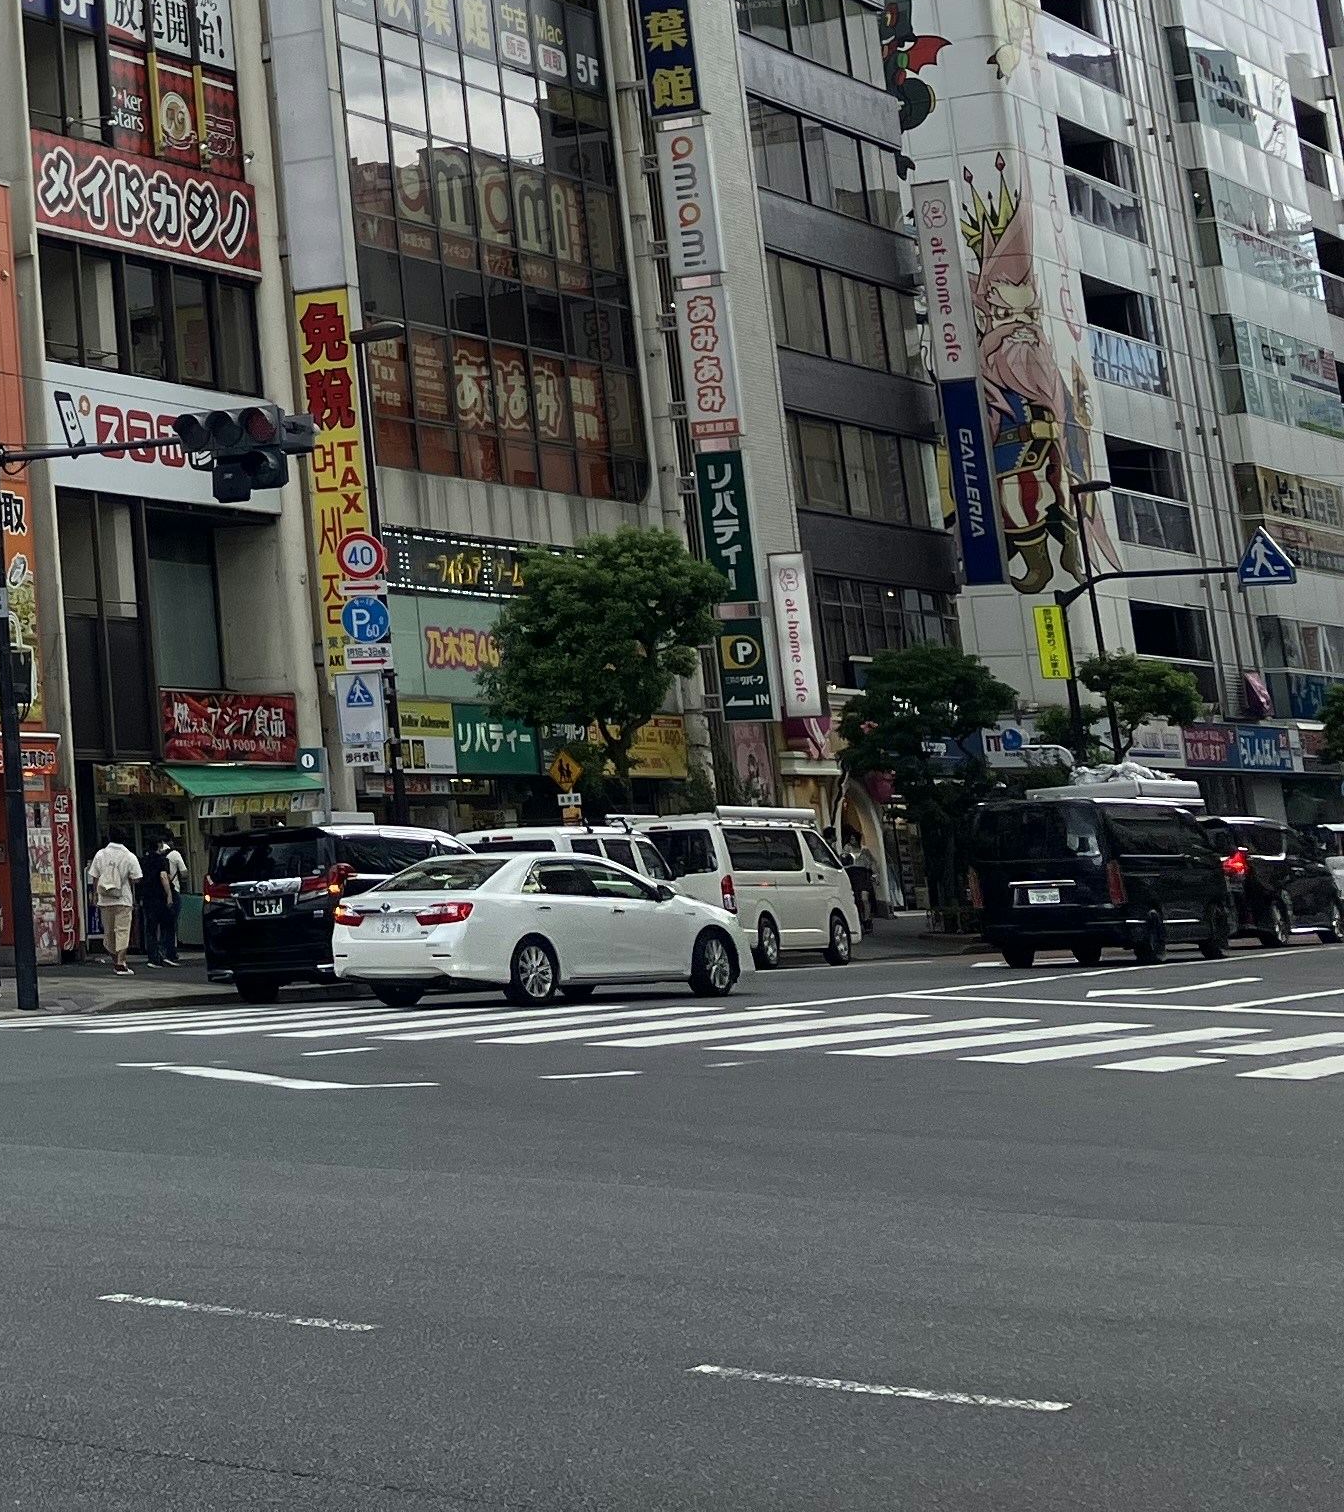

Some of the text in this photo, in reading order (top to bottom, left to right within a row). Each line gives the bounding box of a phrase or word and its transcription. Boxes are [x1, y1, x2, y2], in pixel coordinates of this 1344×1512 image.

[576, 53, 600, 86] 5F
[39, 148, 249, 258] メイドカジノ
[669, 135, 708, 269] amiami
[685, 295, 728, 414] あみあみ
[942, 319, 962, 364] cafe
[301, 303, 356, 431] 免税
[957, 428, 986, 540] GALLERIA
[704, 463, 743, 592] リバティー
[348, 547, 373, 566] 40
[351, 609, 370, 638] P
[756, 694, 771, 706] IN
[793, 662, 807, 704] cafe
[212, 739, 231, 751] ASIA
[233, 740, 257, 752] FOOD
[259, 740, 282, 753] MART
[457, 722, 532, 753] リバティー
